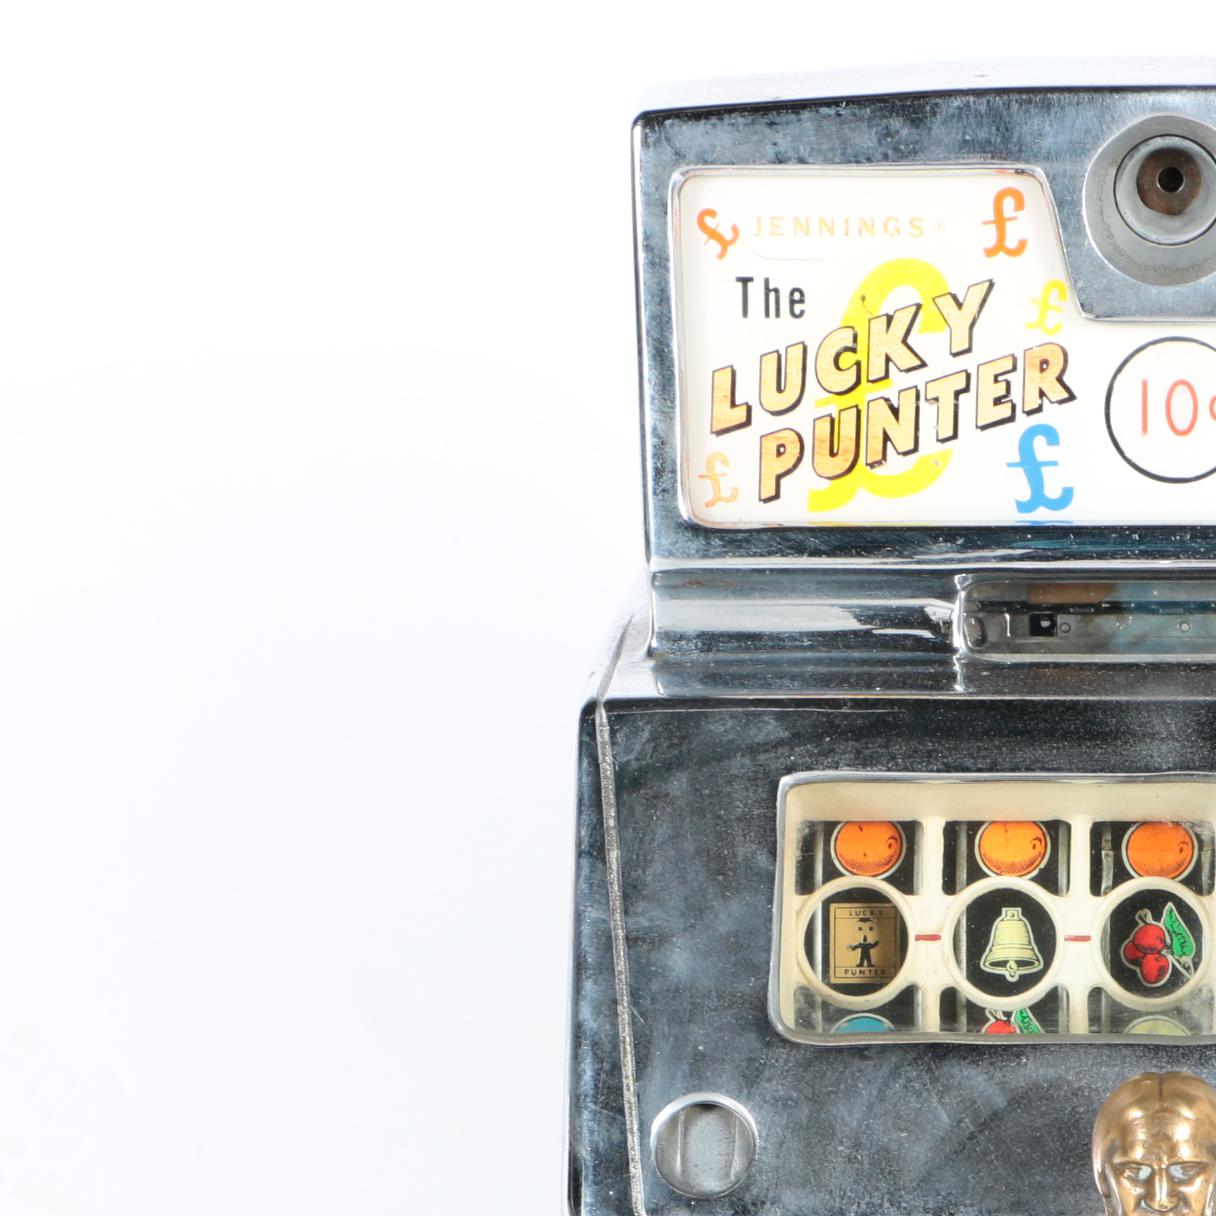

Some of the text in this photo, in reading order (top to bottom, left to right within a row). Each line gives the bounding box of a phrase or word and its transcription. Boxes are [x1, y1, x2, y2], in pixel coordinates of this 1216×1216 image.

[753, 215, 925, 238] JENNINGS
[735, 276, 806, 319] The
[710, 279, 995, 435] LUCKY
[758, 342, 1077, 504] PUNTER
[844, 968, 887, 976] PUNTER
